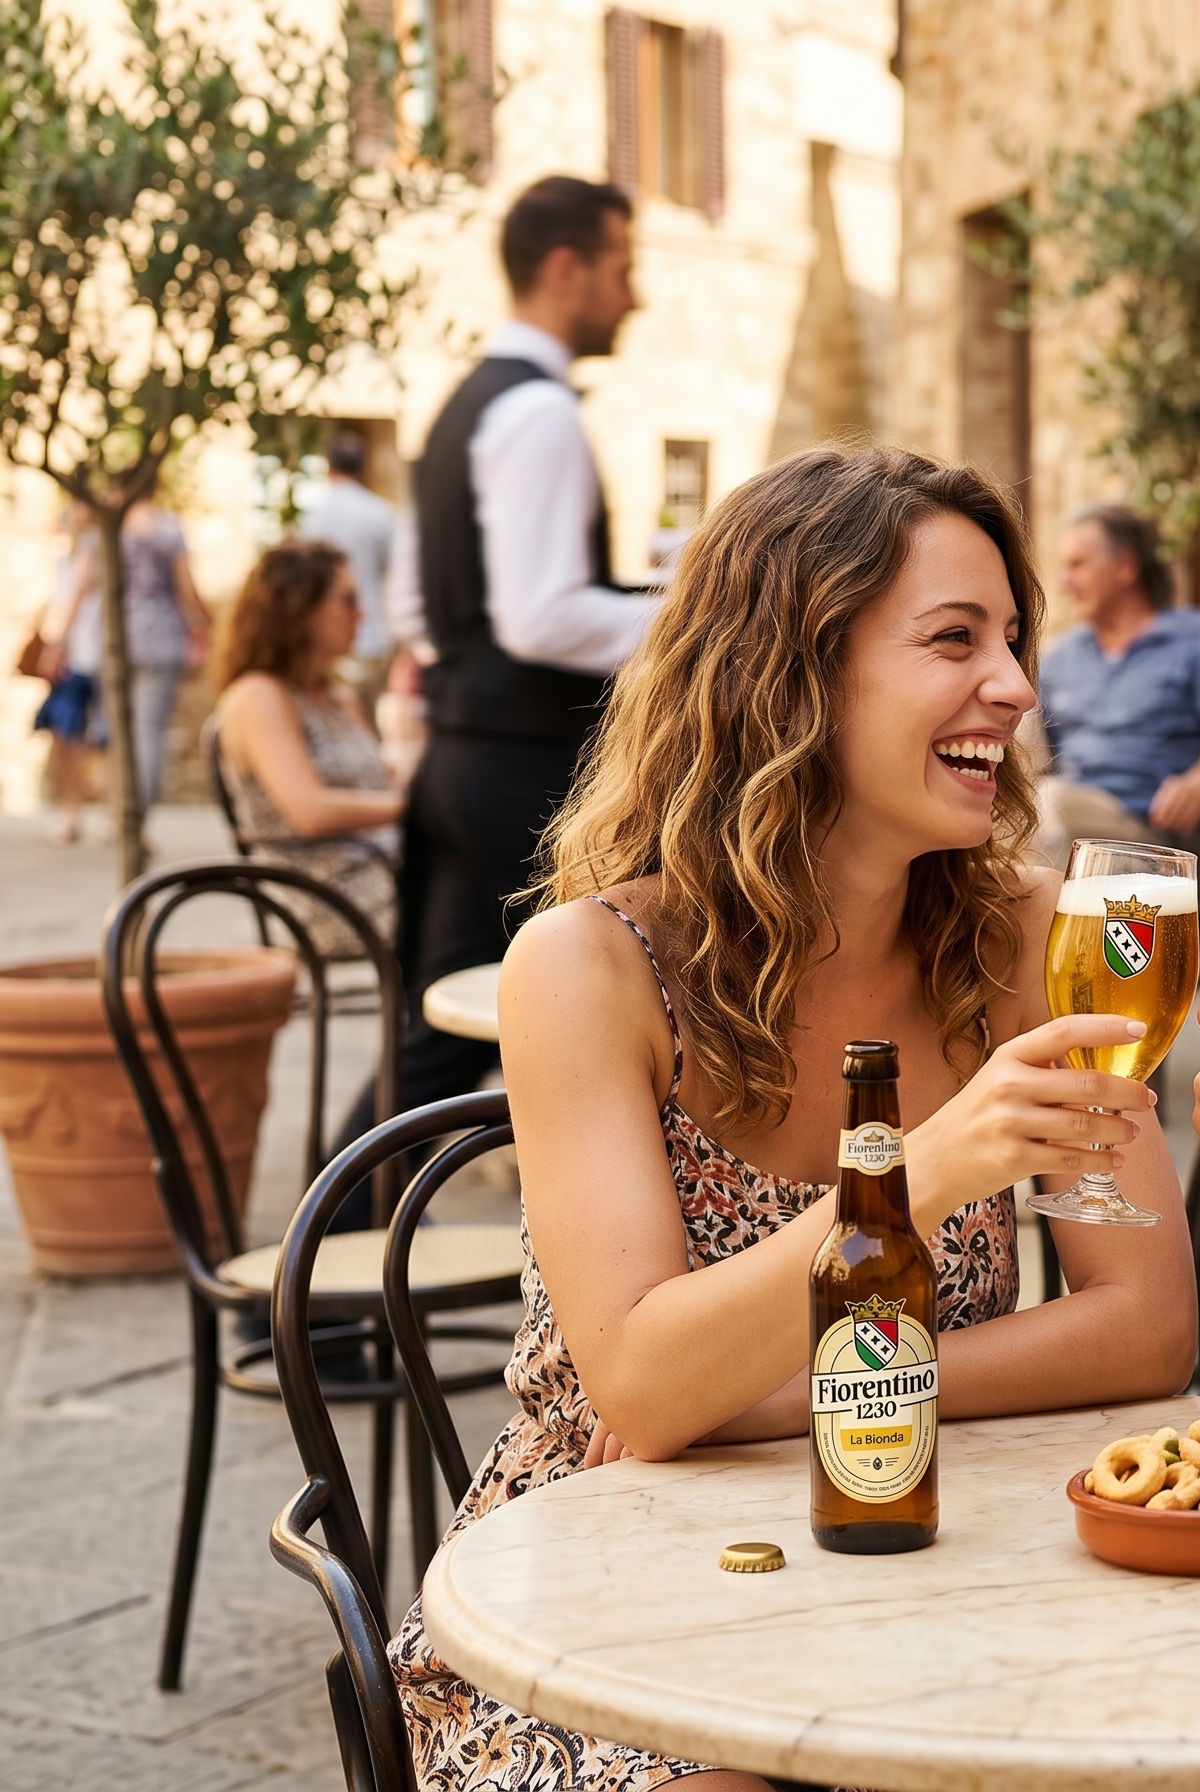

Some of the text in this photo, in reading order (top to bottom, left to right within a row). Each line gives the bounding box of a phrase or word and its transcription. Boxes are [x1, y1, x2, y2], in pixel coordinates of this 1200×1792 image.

[818, 1369, 935, 1404] Fiorentino
[856, 1401, 897, 1419] 1230
[850, 1432, 904, 1445] La Bionda
